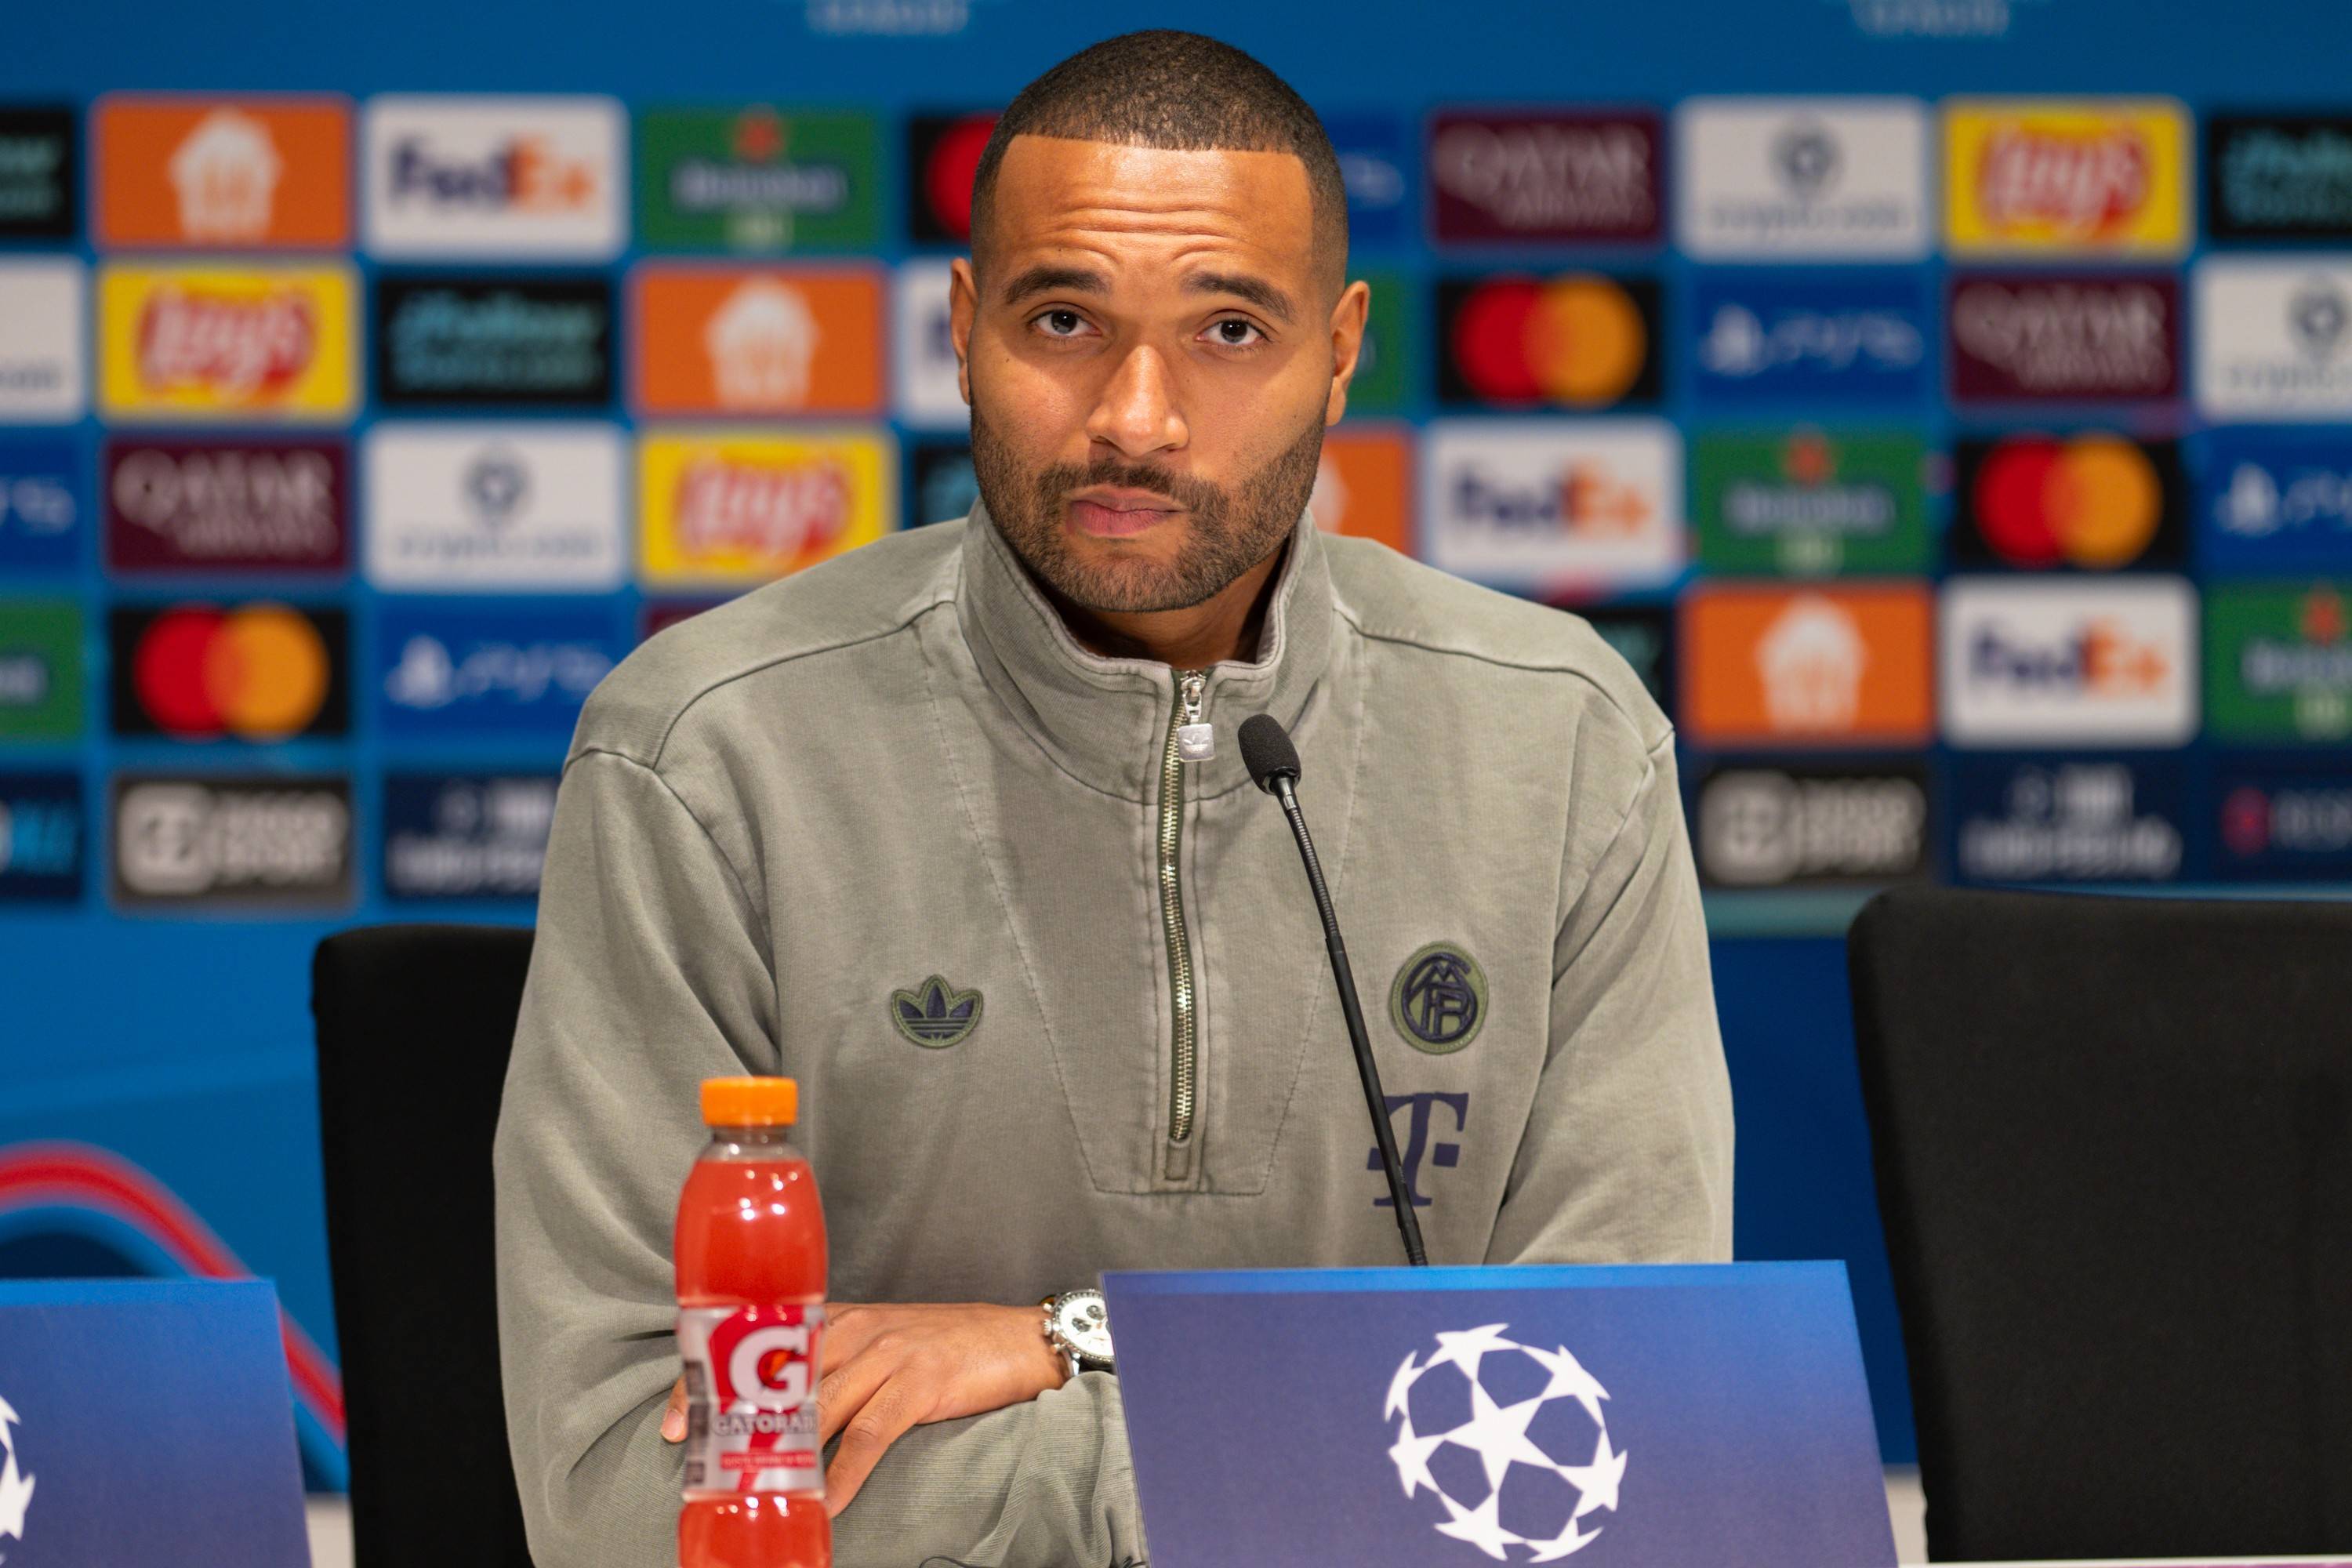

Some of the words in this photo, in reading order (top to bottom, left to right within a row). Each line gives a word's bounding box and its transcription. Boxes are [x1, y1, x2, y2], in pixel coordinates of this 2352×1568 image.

[390, 135, 596, 212] FedEx
[1968, 619, 2170, 696] FedEx
[728, 1323, 810, 1412] G
